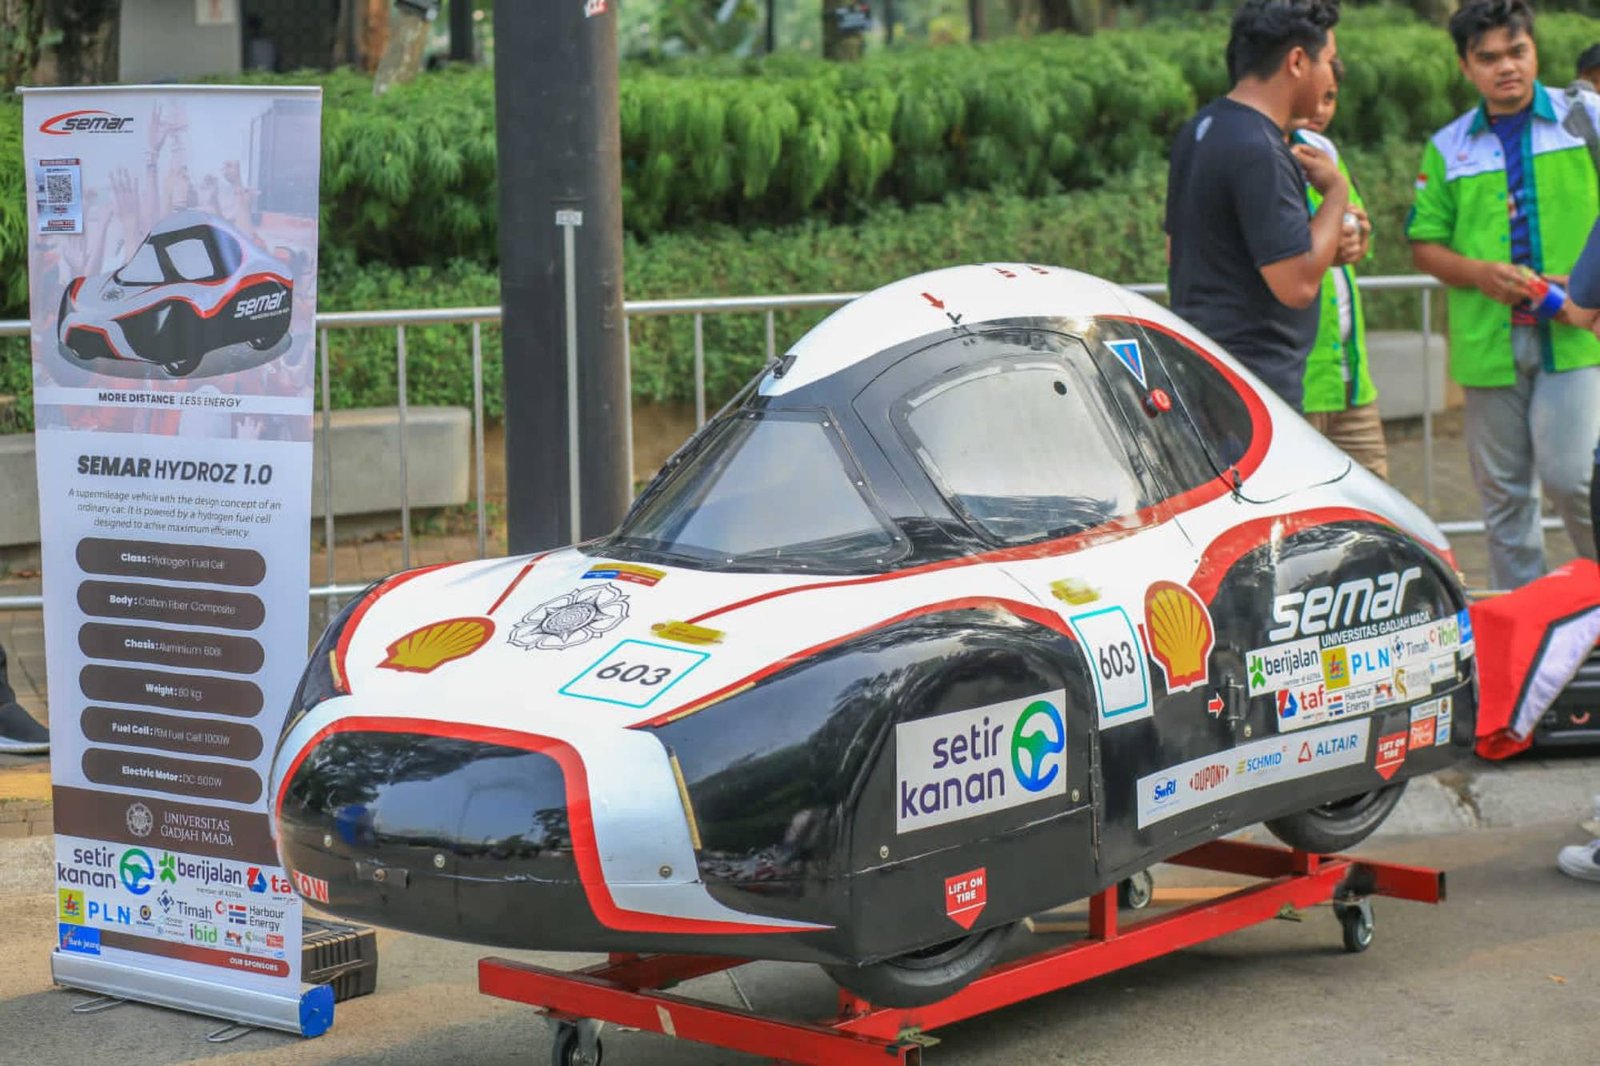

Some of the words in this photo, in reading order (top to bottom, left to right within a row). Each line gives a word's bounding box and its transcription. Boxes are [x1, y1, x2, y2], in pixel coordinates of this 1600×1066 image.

[62, 117, 134, 130] semar
[234, 290, 288, 318] semar
[98, 392, 127, 402] MORE
[129, 393, 175, 405] DISTANCE
[180, 395, 202, 405] LESS
[204, 396, 241, 408] ENERGY
[77, 455, 151, 478] SEMAR
[154, 459, 238, 483] HYDROZ
[243, 463, 272, 485] 1.0
[68, 488, 75, 496] A
[76, 489, 130, 502] supermileage
[131, 492, 159, 502] vehicle
[160, 495, 176, 503] with
[178, 495, 193, 504] the
[195, 497, 219, 508] design
[220, 499, 257, 509] concept
[258, 499, 269, 509] of
[269, 501, 281, 510] an
[77, 503, 110, 515] ordinary
[127, 505, 134, 514] It
[136, 506, 142, 515] is
[143, 508, 176, 519] powered
[177, 509, 189, 519] by
[190, 511, 196, 519] a
[198, 510, 233, 523] hydrogen
[236, 513, 253, 523] fuel
[255, 514, 272, 524] cell
[94, 517, 132, 529] designed
[133, 519, 143, 529] to
[167, 522, 210, 534] maximum
[211, 526, 249, 538] efficiency
[152, 555, 190, 569] Hydrogen
[191, 558, 210, 569] Fuel
[210, 560, 225, 570] Cell
[138, 596, 168, 609] Carbon
[168, 599, 188, 610] Fiber
[190, 601, 236, 615] Composite
[1270, 567, 1422, 642] semar
[1321, 626, 1379, 648] UNIVERSITAS
[1379, 618, 1409, 634] GADJAH
[1410, 611, 1431, 627] MADA
[1437, 623, 1458, 647] ibid
[1406, 641, 1429, 658] Timah
[1099, 641, 1136, 680] 603
[1264, 649, 1319, 676] berijalan
[596, 661, 672, 686] 603
[191, 689, 202, 702] kg
[1300, 683, 1324, 711] taf
[1344, 685, 1372, 699] Harbour
[1345, 700, 1370, 715] Energy
[112, 722, 131, 733] Fuel
[168, 730, 184, 740] Fuel
[186, 732, 202, 743] Cell
[932, 716, 1004, 769] setir
[1315, 734, 1359, 757] ALTAIR
[1379, 741, 1394, 752] LIFT
[1384, 749, 1398, 760] TIRE
[1247, 752, 1282, 772] SCHMID
[122, 765, 154, 777] Electric
[183, 773, 195, 783] DC
[197, 774, 222, 787] 500W
[1194, 765, 1226, 791] DUPONT
[900, 767, 1006, 819] kanan
[1154, 779, 1176, 800] SwRI
[164, 811, 230, 832] UNIVERSITAS
[161, 825, 199, 842] GADJAH
[202, 831, 234, 846] MADA
[74, 846, 115, 868] setir
[57, 862, 116, 889] kanan
[177, 857, 242, 885] berijalan
[949, 881, 967, 895] LIFT
[970, 876, 983, 888] ON
[957, 889, 976, 904] TIRE
[176, 901, 212, 920] Timah
[249, 906, 284, 919] Harbour
[190, 923, 217, 943] ibid
[249, 917, 280, 931] Energy
[229, 957, 244, 966] OUR
[245, 959, 279, 971] SPONSORS
